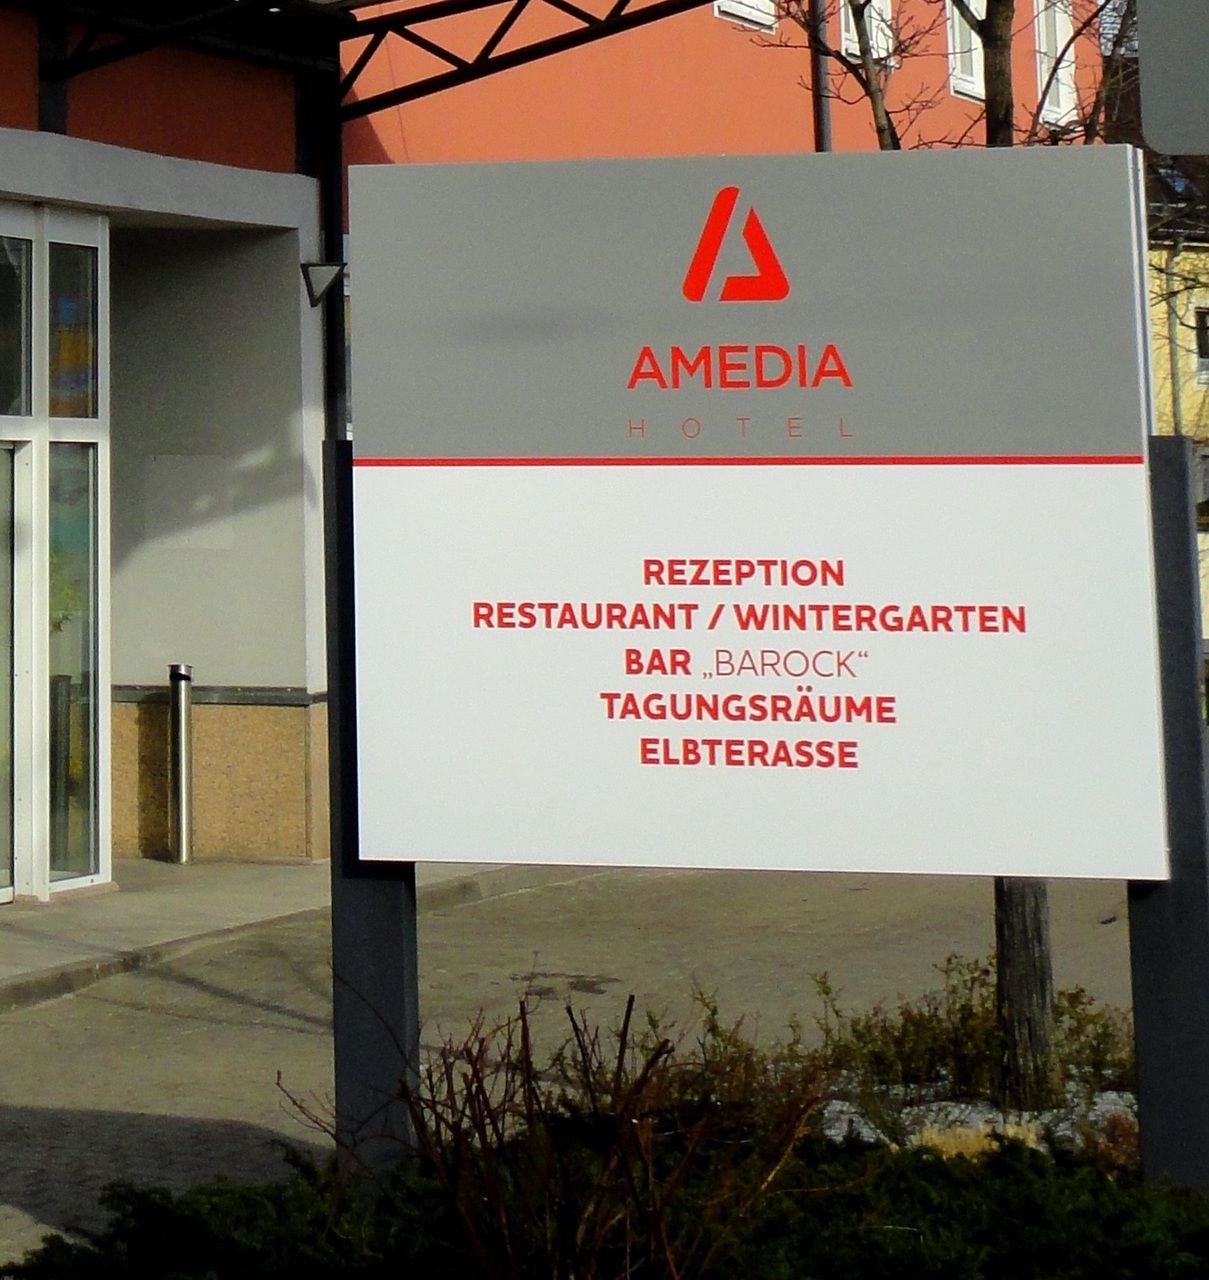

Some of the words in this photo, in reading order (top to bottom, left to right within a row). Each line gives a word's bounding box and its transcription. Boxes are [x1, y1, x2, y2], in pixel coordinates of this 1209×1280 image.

[628, 344, 853, 389] AMEDIA
[628, 417, 853, 439] HOTEL
[643, 558, 845, 587] REZEPTION
[473, 602, 699, 630] RESTAURANT
[733, 603, 1026, 633] WINTERGARTEN
[624, 648, 691, 676] BAR
[600, 685, 897, 724] TAGUNGSRÄUME
[639, 737, 857, 768] ELBTERASSE
